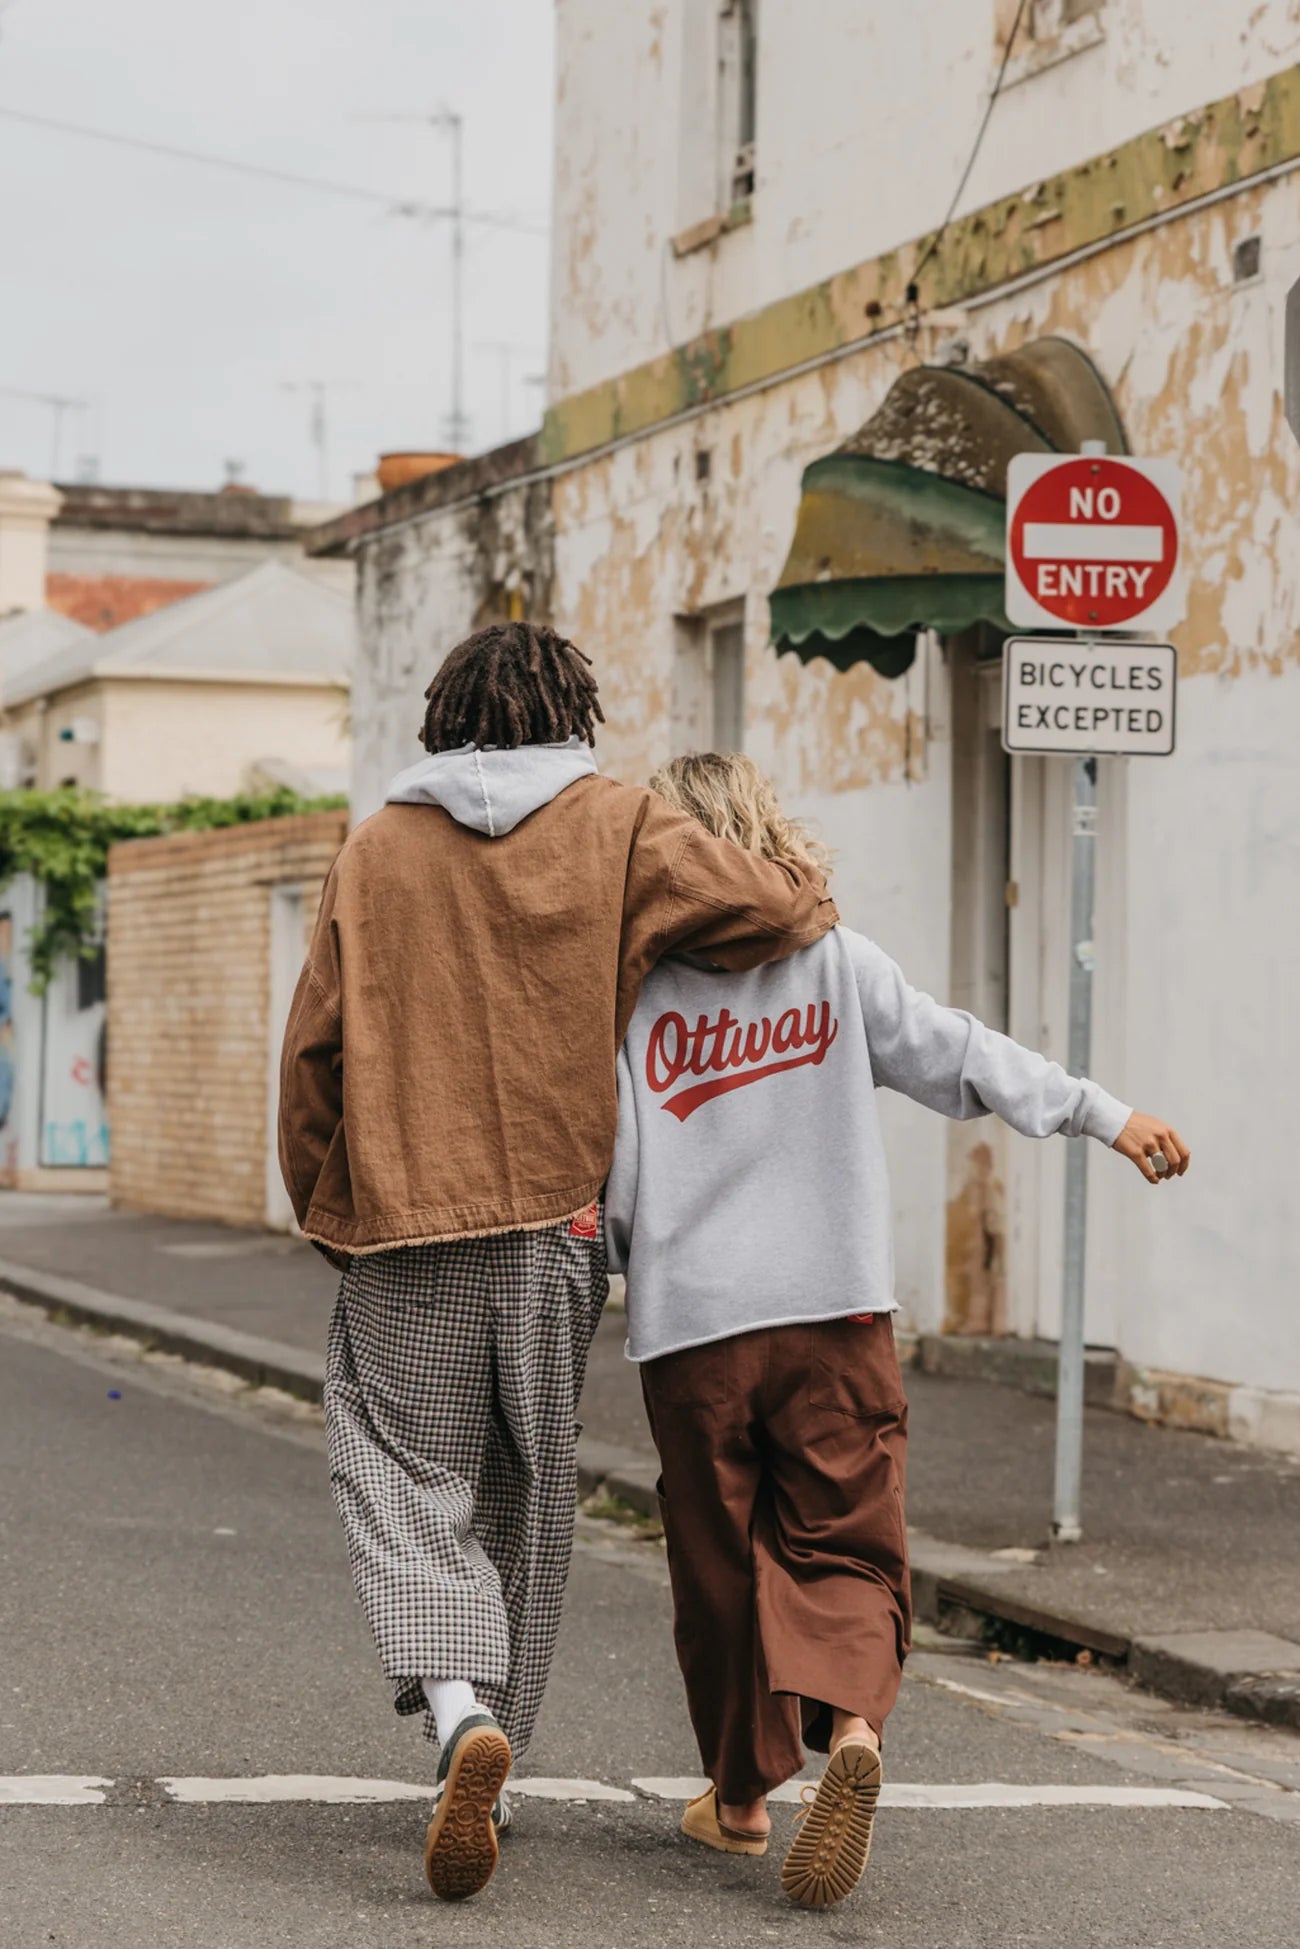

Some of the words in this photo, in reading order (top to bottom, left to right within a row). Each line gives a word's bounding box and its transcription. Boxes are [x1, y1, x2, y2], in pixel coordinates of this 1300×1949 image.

[1069, 487, 1122, 521] NO
[1037, 564, 1152, 598] ENTRY
[1020, 662, 1163, 691] BICYCLES
[1018, 705, 1163, 733] EXCEPTED
[645, 1000, 838, 1093] Ottway
